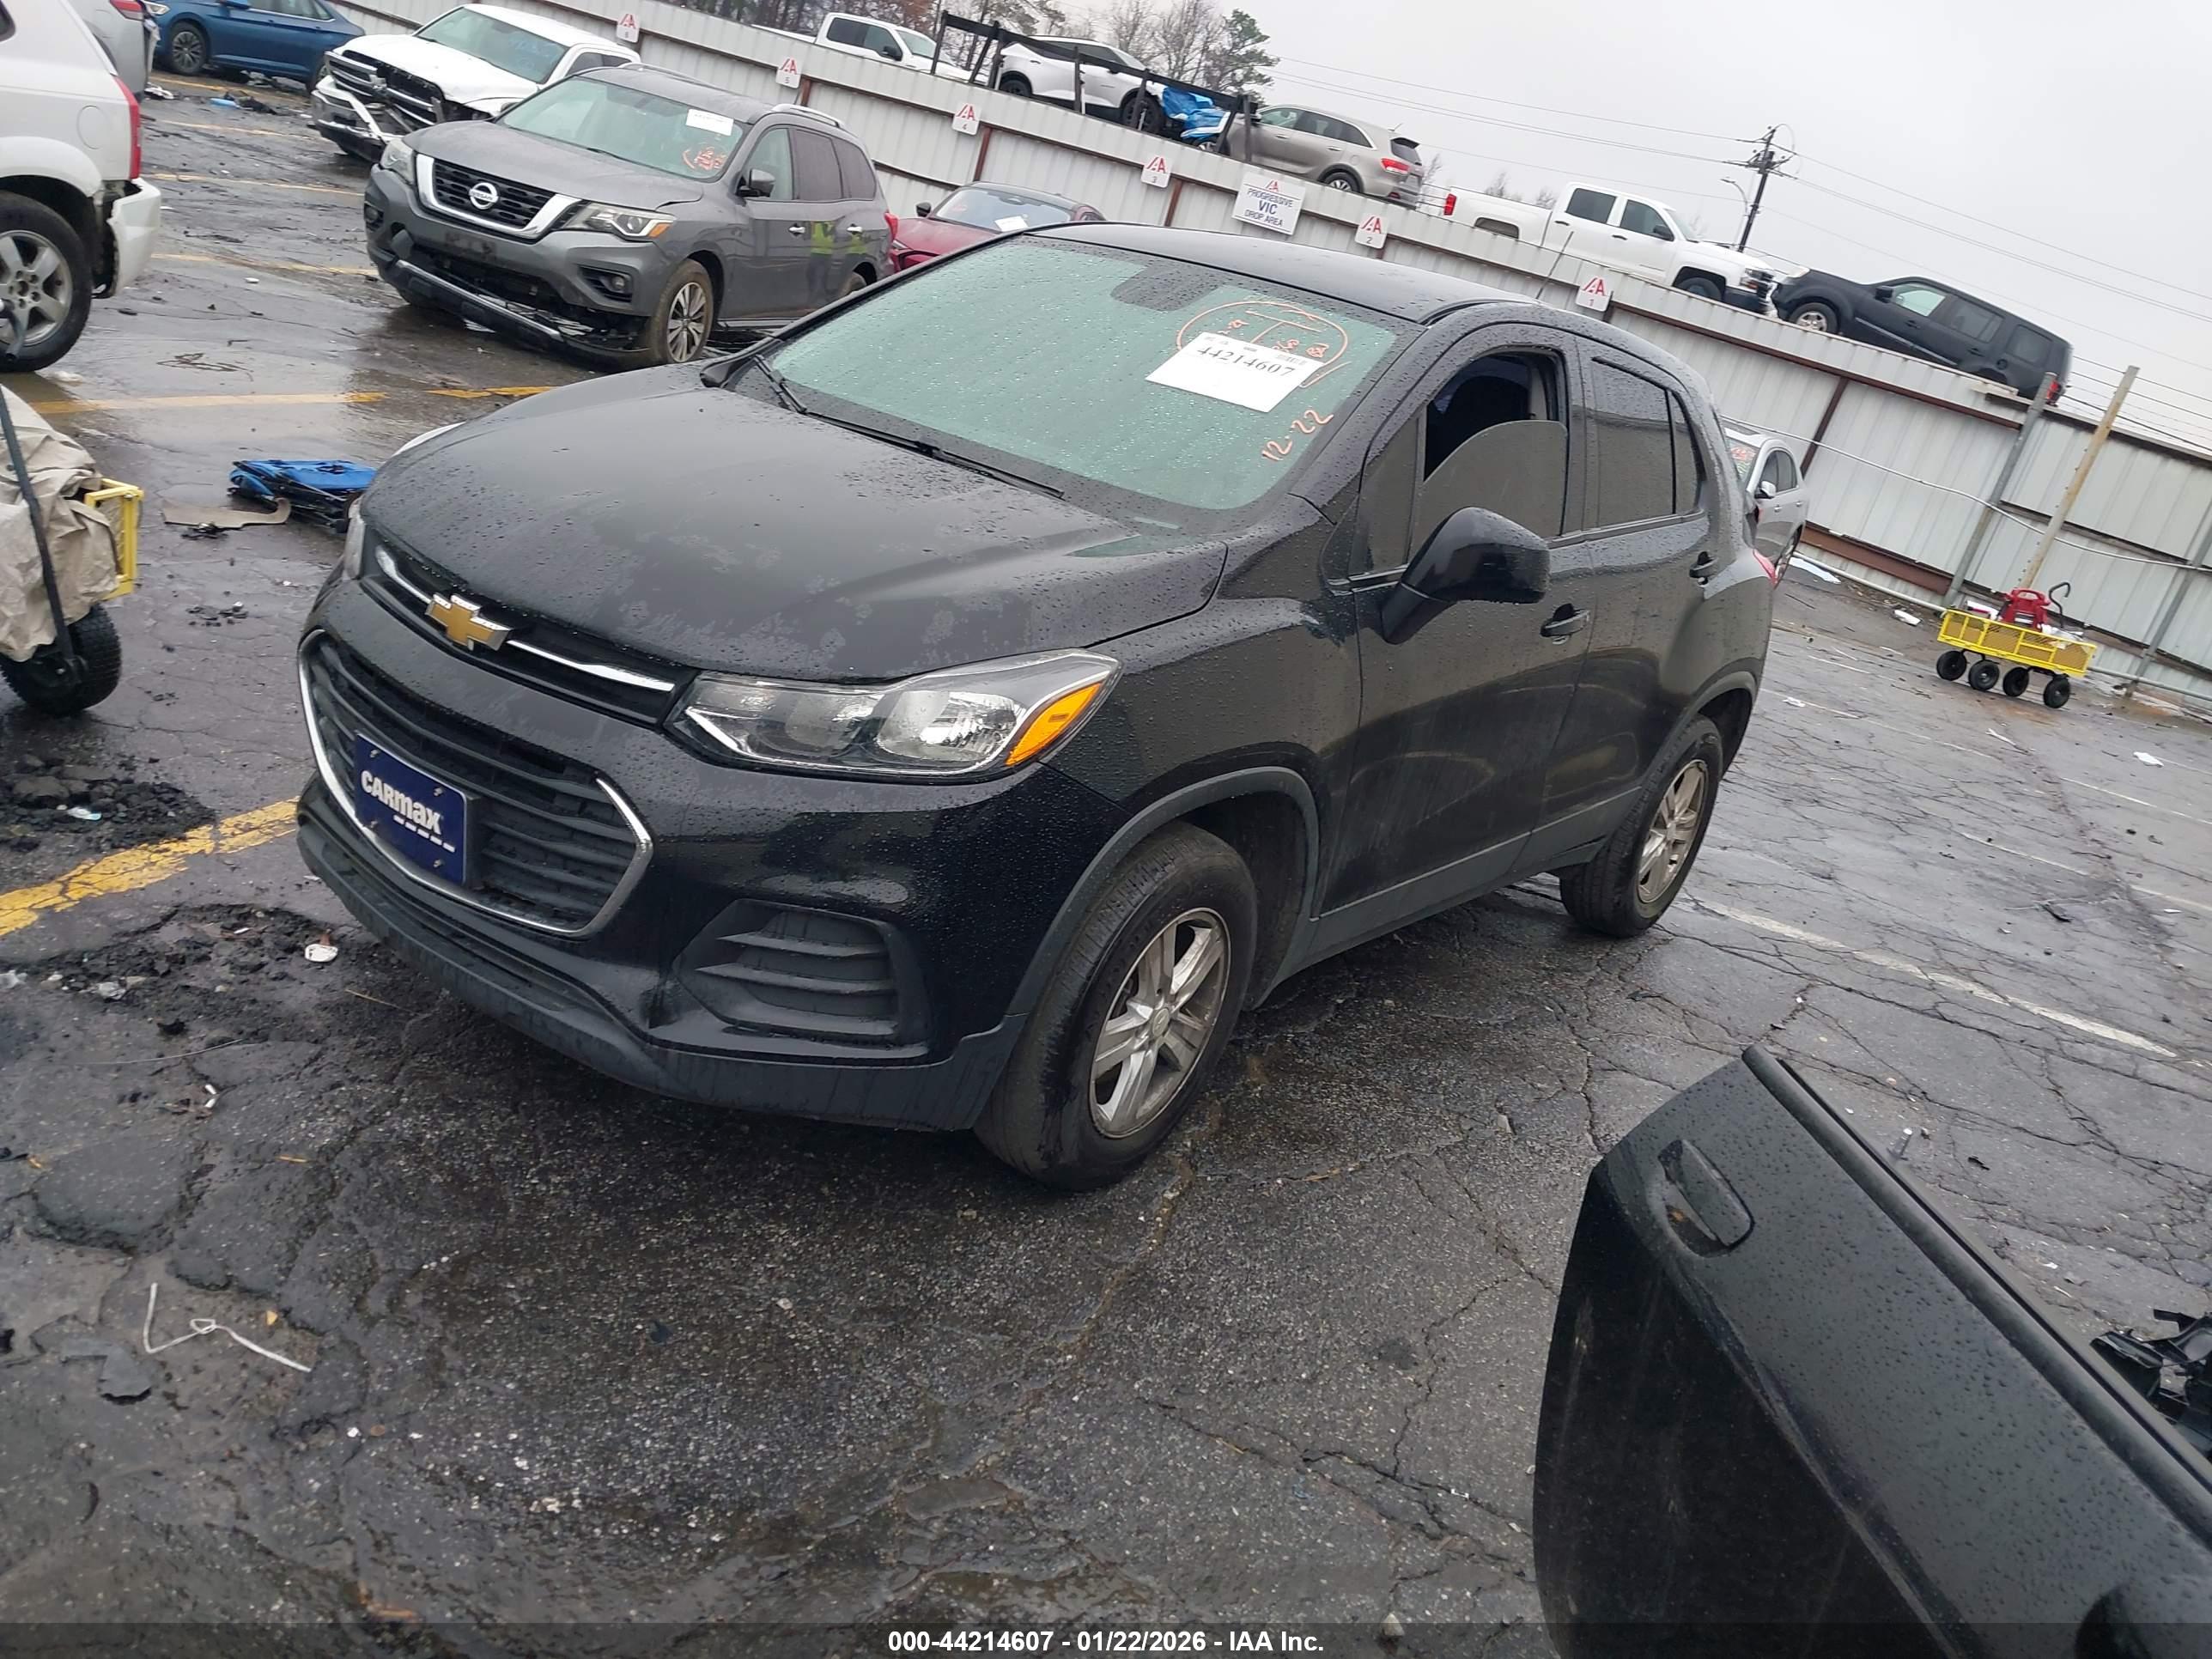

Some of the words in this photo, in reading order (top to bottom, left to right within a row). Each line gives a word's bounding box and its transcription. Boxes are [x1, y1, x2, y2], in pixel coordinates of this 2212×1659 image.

[1244, 209, 1264, 220] DROP
[1259, 199, 1278, 215] VIC
[1197, 346, 1296, 377] 44214607
